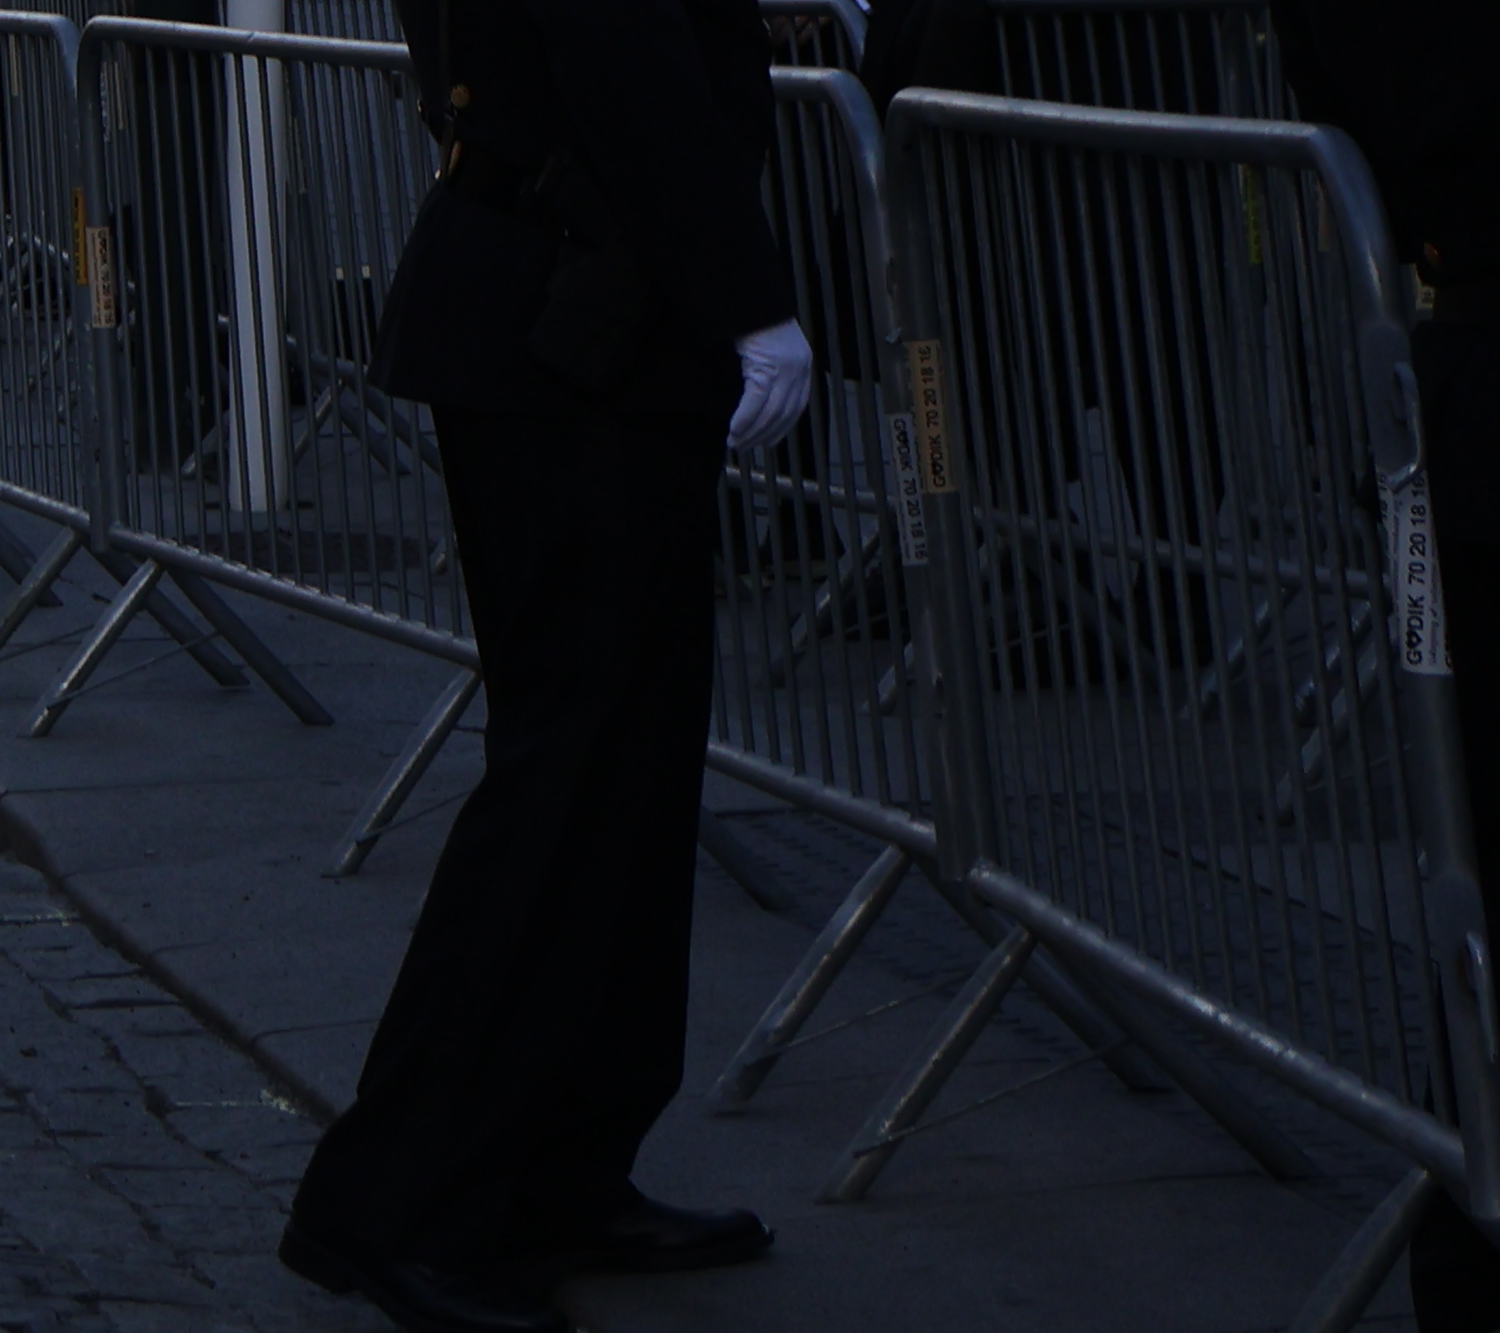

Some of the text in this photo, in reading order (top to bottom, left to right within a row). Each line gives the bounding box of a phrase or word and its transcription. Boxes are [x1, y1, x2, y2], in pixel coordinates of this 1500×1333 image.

[923, 388, 938, 407] 20
[926, 410, 940, 429] 70
[1410, 503, 1427, 527] 18
[1409, 533, 1427, 558] 20
[1408, 562, 1425, 585] 70
